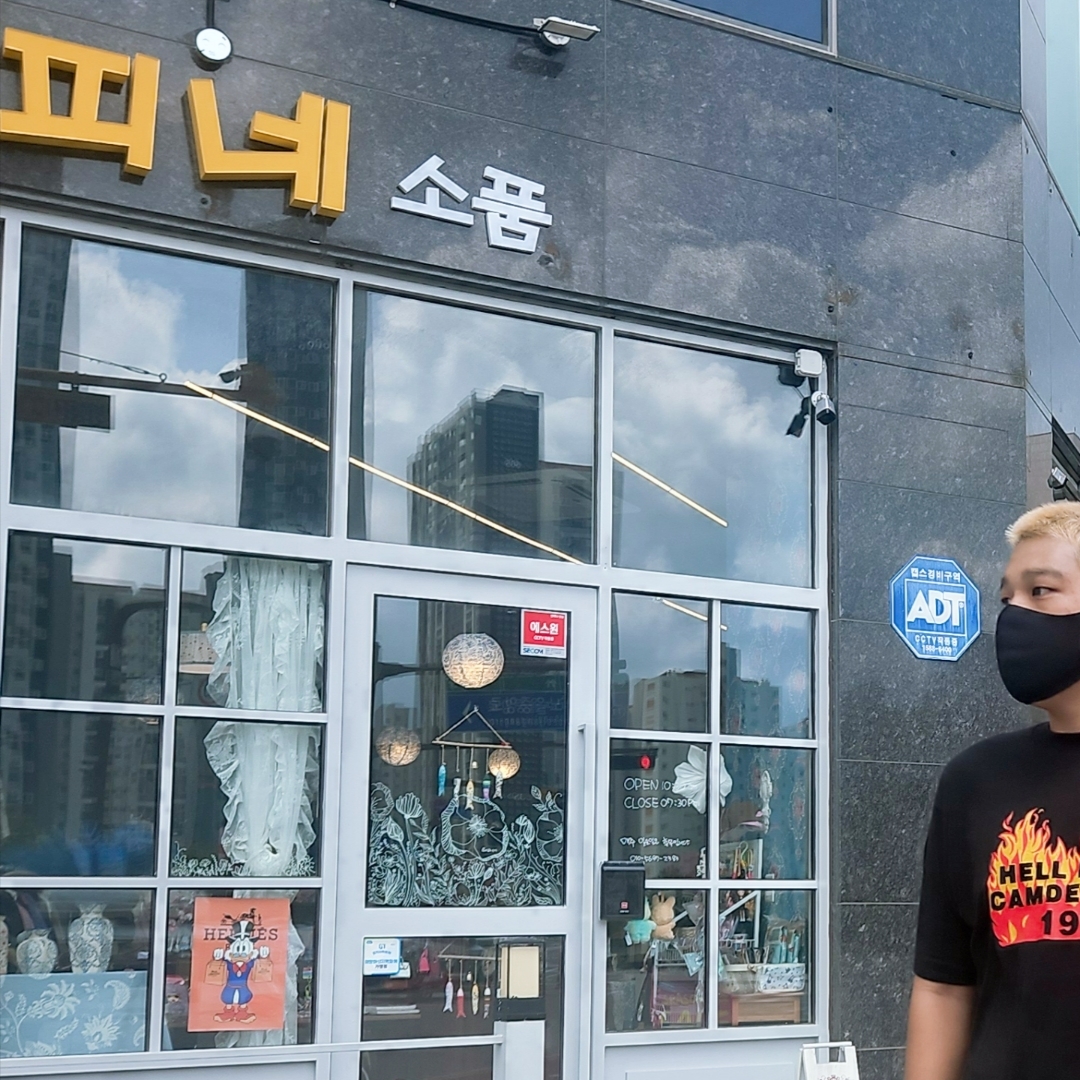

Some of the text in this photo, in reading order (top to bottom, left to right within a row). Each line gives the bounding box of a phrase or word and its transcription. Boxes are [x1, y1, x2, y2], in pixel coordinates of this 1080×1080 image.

[391, 155, 553, 253] 소품
[906, 589, 965, 627] ADT
[530, 621, 559, 635] 에스원
[624, 777, 659, 791] OPEN
[624, 796, 659, 809] CLOSE
[1000, 861, 1067, 884] HELL
